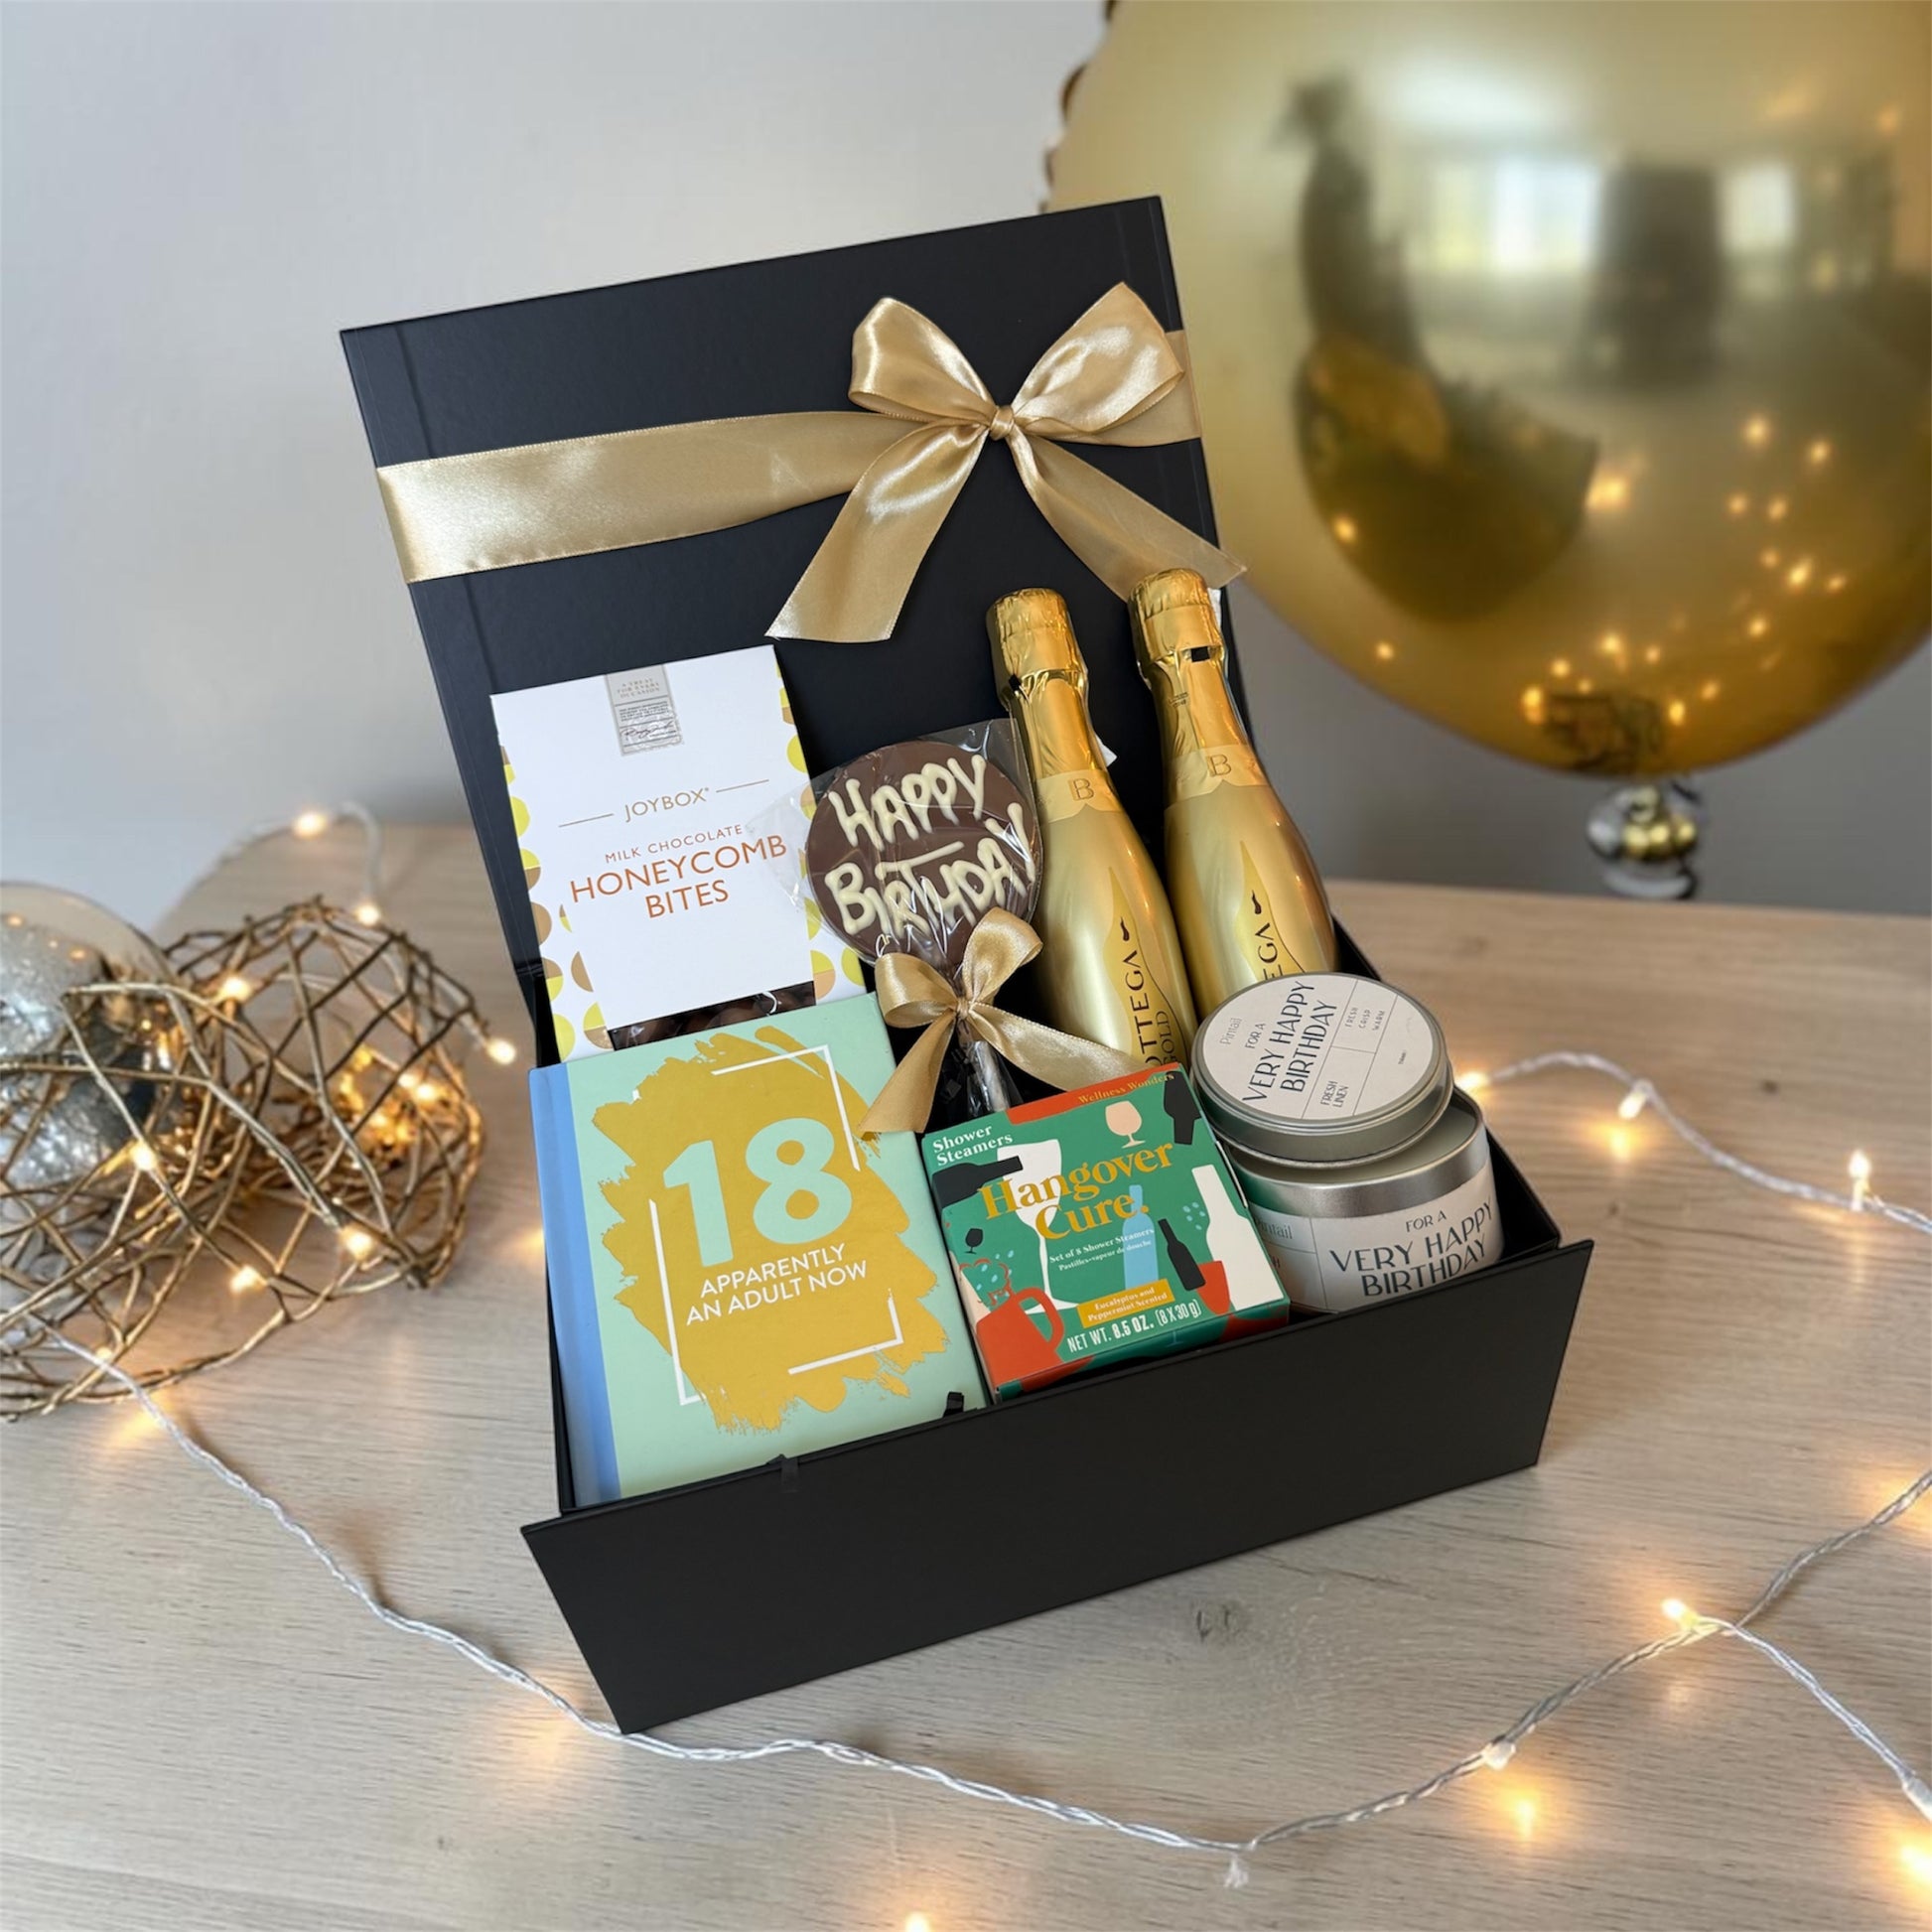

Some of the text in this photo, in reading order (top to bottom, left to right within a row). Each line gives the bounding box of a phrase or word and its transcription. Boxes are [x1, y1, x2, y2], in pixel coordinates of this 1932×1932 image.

[1208, 754, 1232, 776] B
[828, 755, 987, 852] HAPPY
[1069, 777, 1095, 801] B
[606, 824, 743, 864] MILK CHOCOLATE
[570, 834, 787, 903] HONEYCOMB
[824, 802, 1036, 939] BIRTHDAY
[645, 879, 730, 918] BITES
[1242, 981, 1314, 1101] VERY HAPPY
[1245, 1032, 1262, 1049] FOR
[1280, 1000, 1337, 1092] BIRTHDAY
[1077, 1072, 1174, 1104] Wellness Wonders
[1320, 1080, 1337, 1106] FRESH
[1332, 1085, 1349, 1108] LINEN
[932, 1126, 993, 1154] Shower
[936, 1133, 1014, 1167] Steamers
[662, 1117, 852, 1268] 18
[977, 1143, 1173, 1220] Hangover
[1035, 1193, 1150, 1239] Cure.
[1406, 1210, 1447, 1233] FOR A
[1049, 1253, 1064, 1263] Set
[1065, 1249, 1074, 1259] of
[1083, 1240, 1114, 1253] Shower
[1115, 1229, 1155, 1243] Steamers
[1117, 1246, 1125, 1255] de
[1330, 1201, 1492, 1272] VERY HAPPY
[700, 1242, 845, 1299] APPARENTLY
[1361, 1233, 1486, 1297] BIRTHDAY
[686, 1260, 867, 1326] AN ADULT NOW
[1087, 1293, 1168, 1322] Peppermint Scented
[1094, 1287, 1155, 1311] Eucalyptus and
[1067, 1299, 1202, 1352] NET WT. 8.5 OZ. (8 X 30 g)
